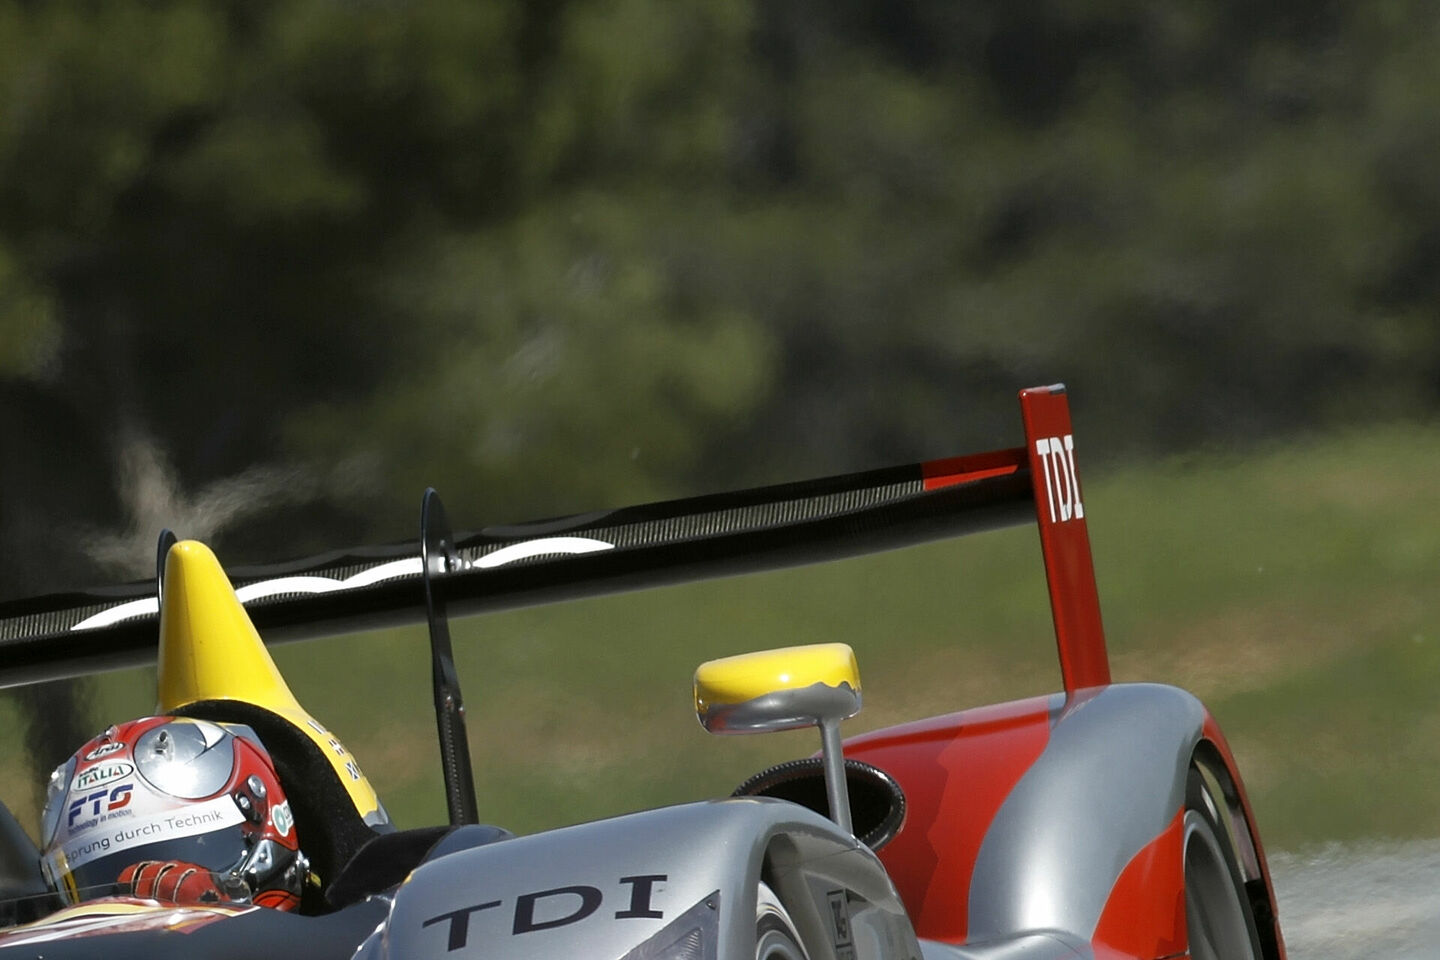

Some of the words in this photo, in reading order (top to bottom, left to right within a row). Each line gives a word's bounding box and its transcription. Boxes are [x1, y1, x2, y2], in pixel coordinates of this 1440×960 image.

[1035, 434, 1085, 523] TDI
[77, 765, 125, 789] ITALIA
[68, 783, 134, 827] FTS
[115, 822, 162, 843] durch
[165, 810, 224, 831] Technik
[422, 874, 668, 952] TDI
